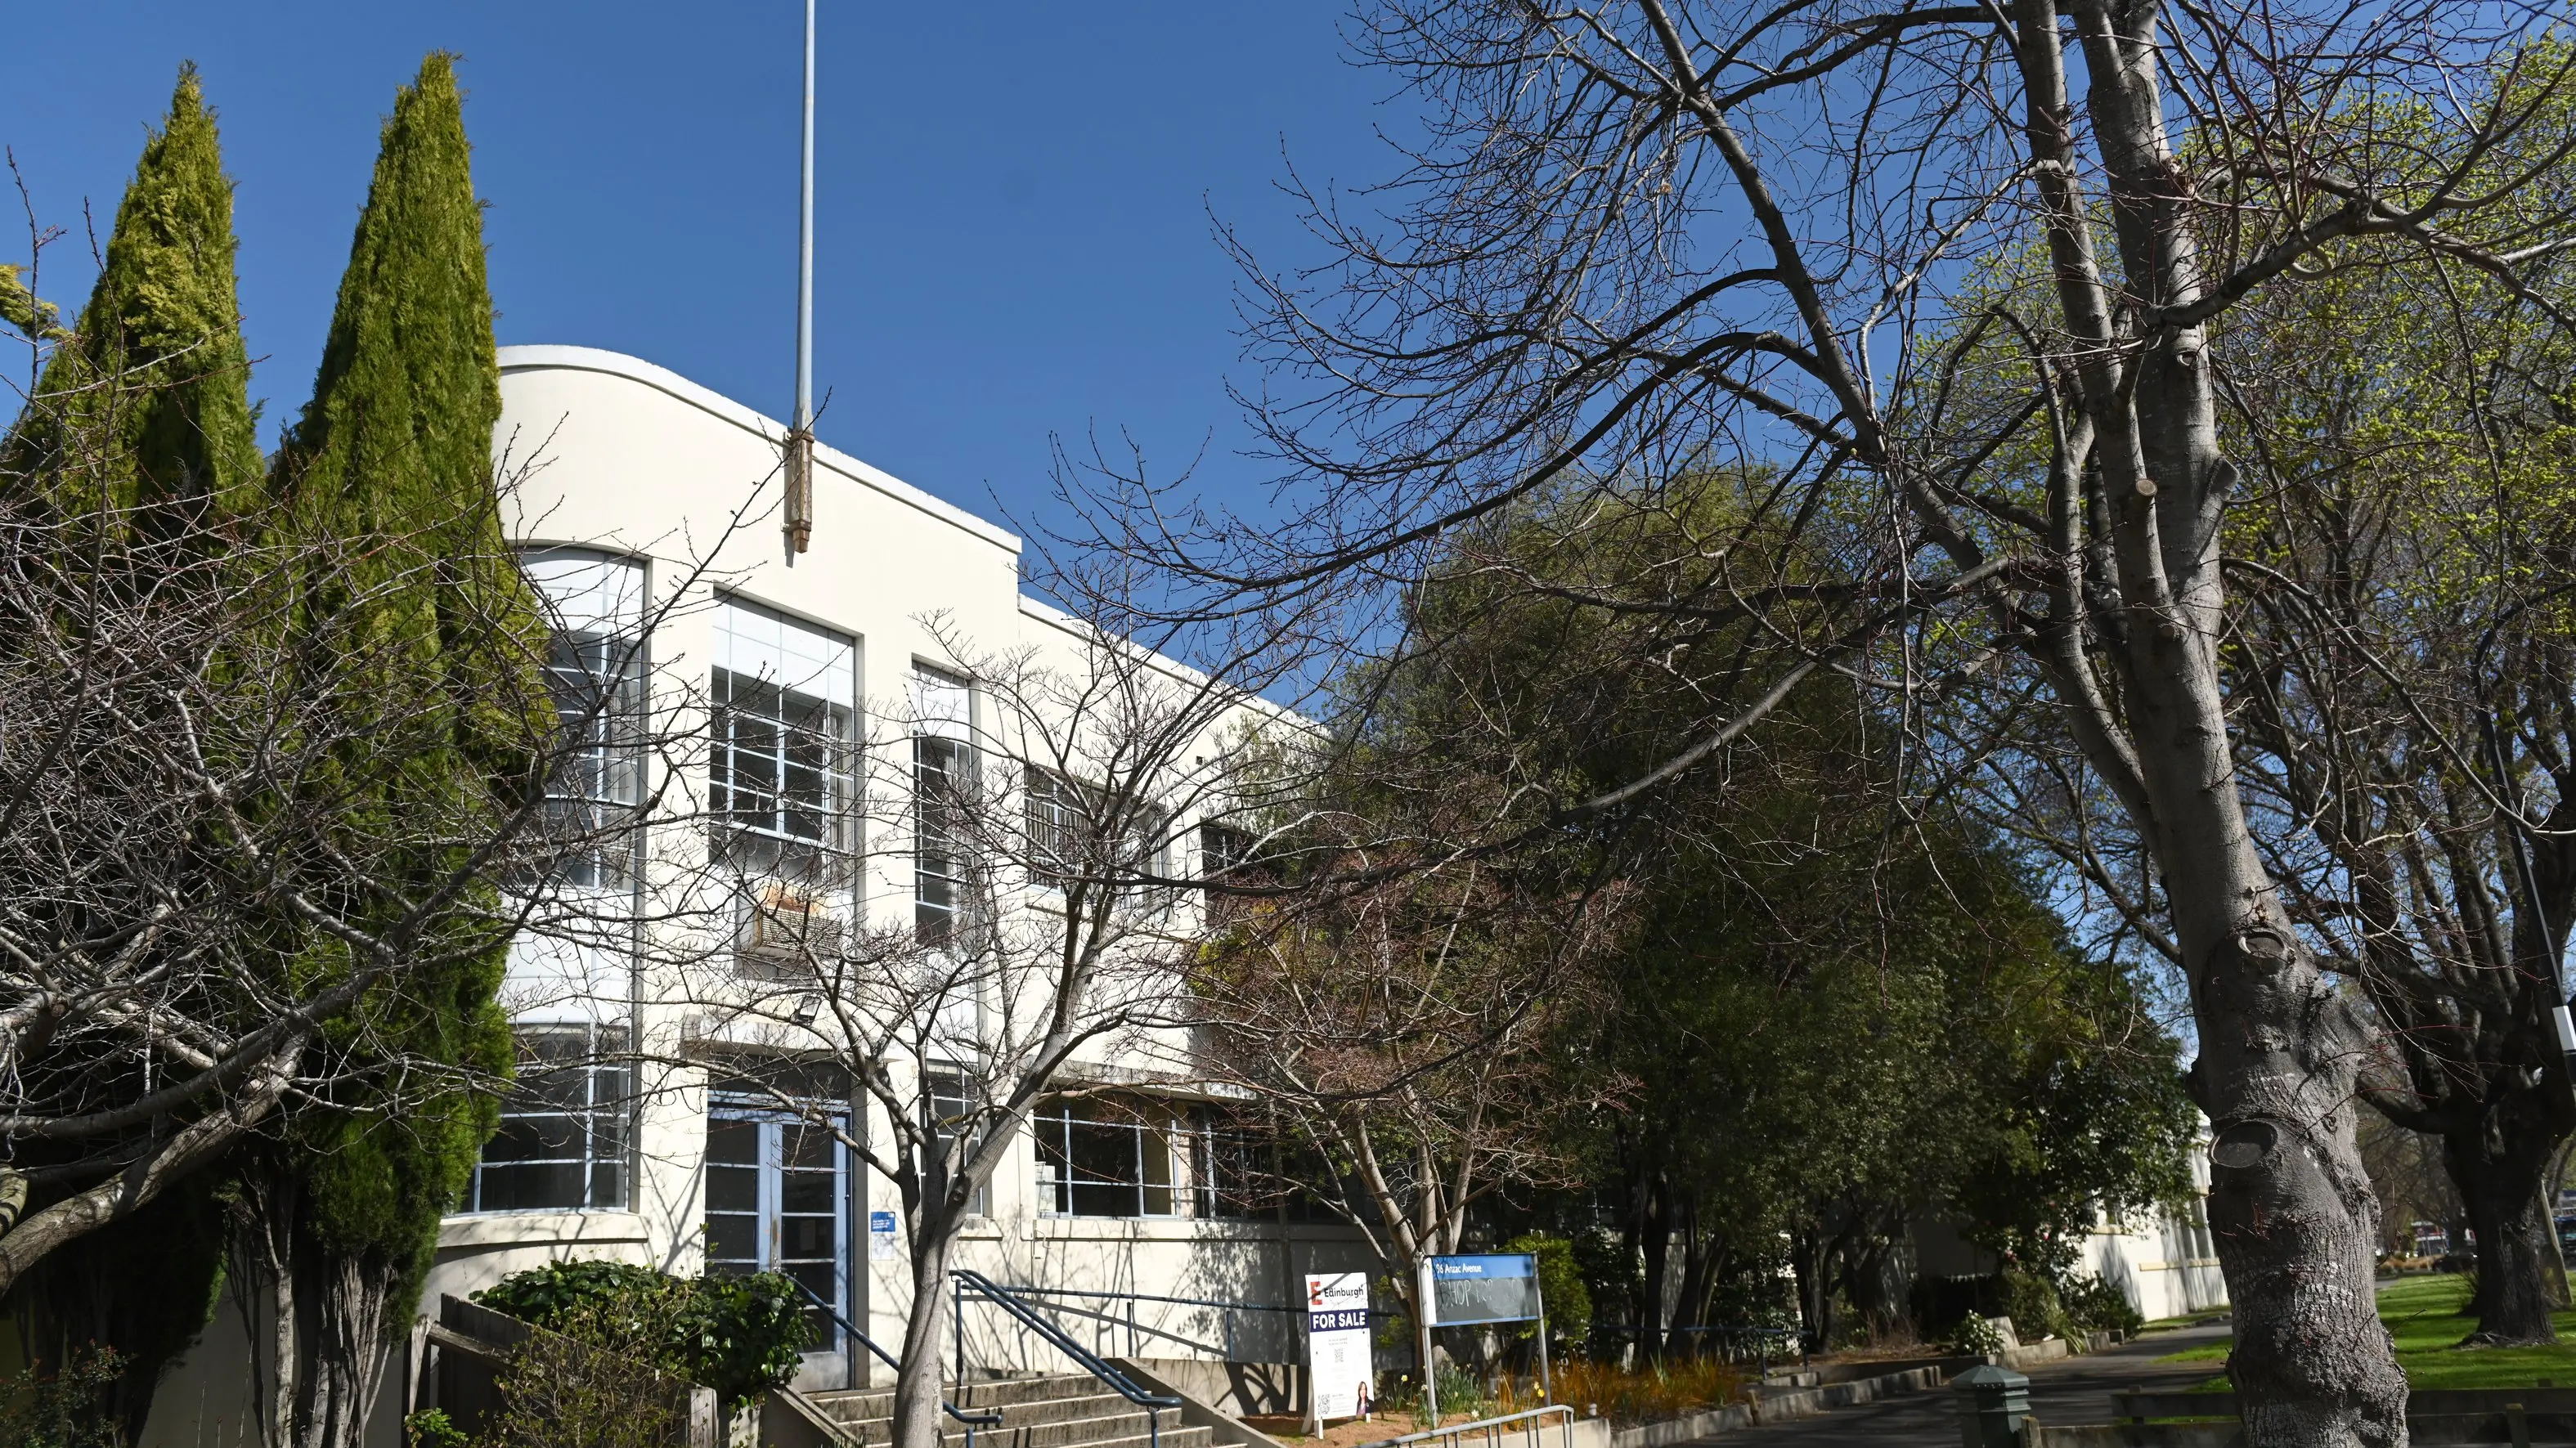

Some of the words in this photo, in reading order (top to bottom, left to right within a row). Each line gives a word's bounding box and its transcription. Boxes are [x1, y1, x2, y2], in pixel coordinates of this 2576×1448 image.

[1436, 1263, 1443, 1274] 96
[1445, 1263, 1461, 1274] Anzac
[1462, 1262, 1482, 1273] Avenue
[1310, 1281, 1322, 1305] E
[1324, 1286, 1364, 1298] Edinburgh
[1313, 1314, 1335, 1329] FOR
[1339, 1311, 1366, 1328] SALE
